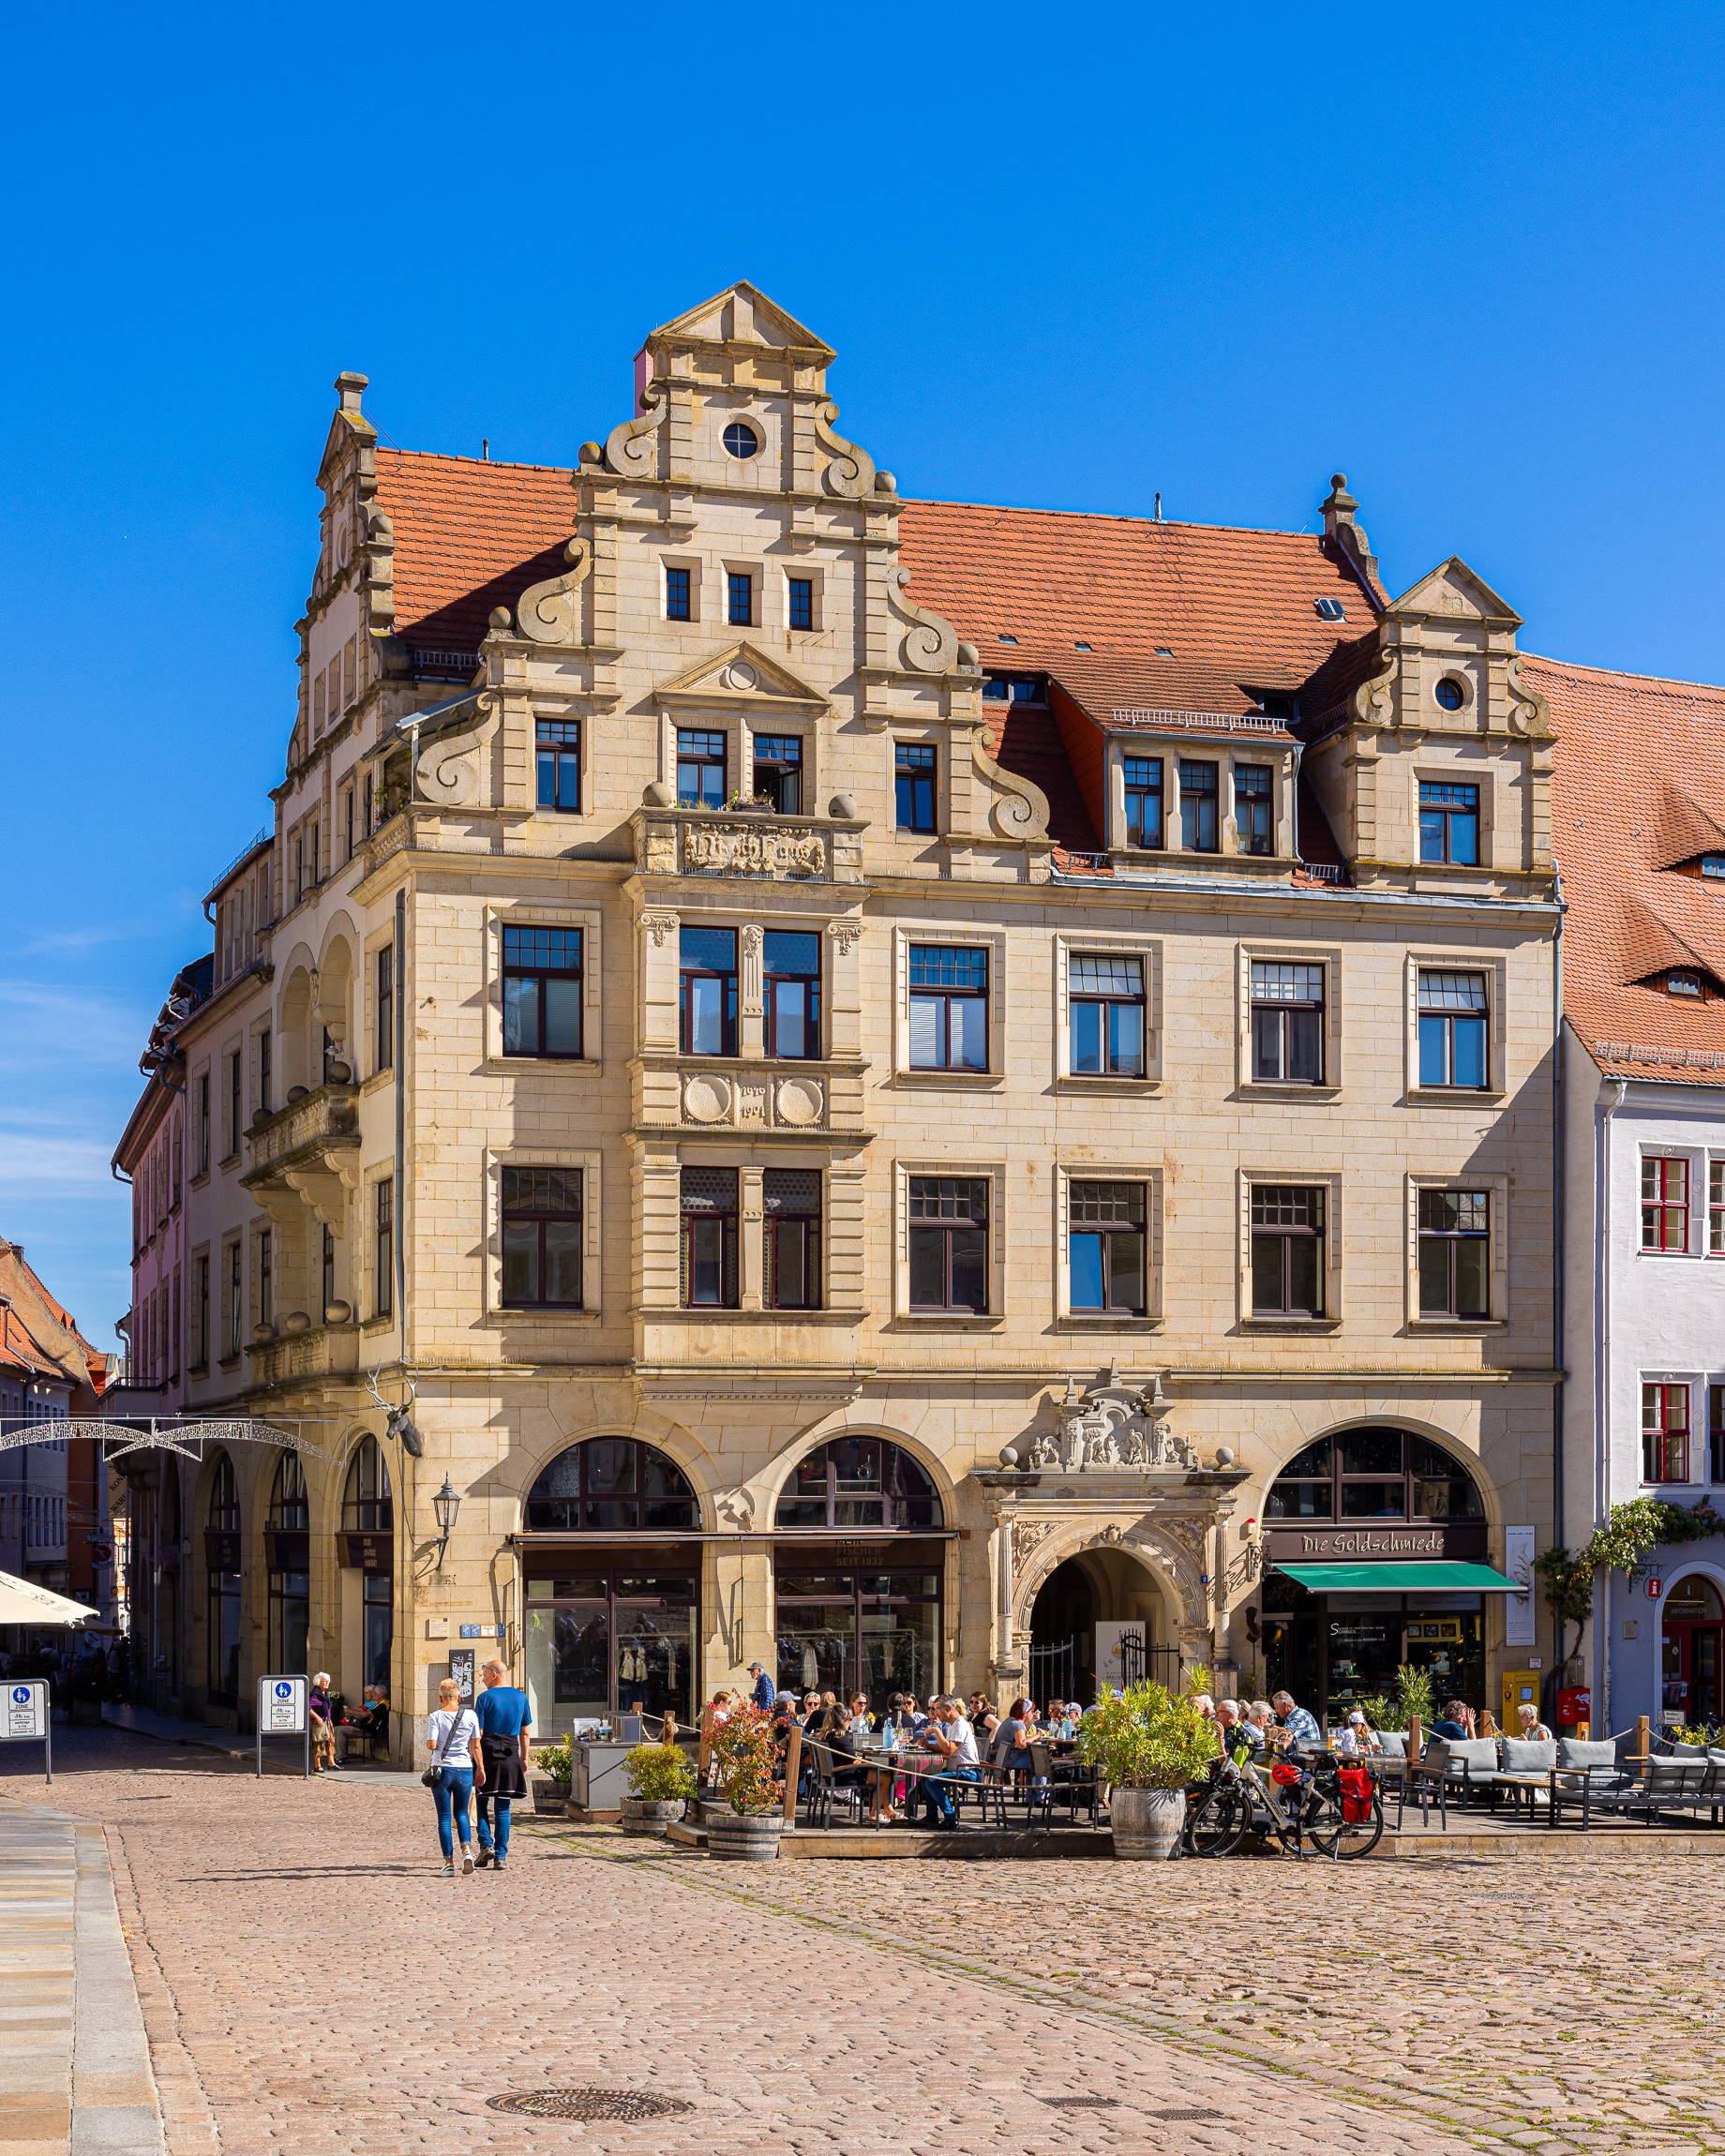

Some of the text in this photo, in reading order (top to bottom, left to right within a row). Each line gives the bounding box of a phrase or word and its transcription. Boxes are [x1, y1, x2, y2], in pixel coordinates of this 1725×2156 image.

[742, 1086, 766, 1097] 1646
[742, 1106, 766, 1117] 1901
[1302, 1532, 1445, 1554] Die Goldschmiede
[836, 1547, 881, 1555] FISCHER
[836, 1557, 883, 1565] SEIT 1832
